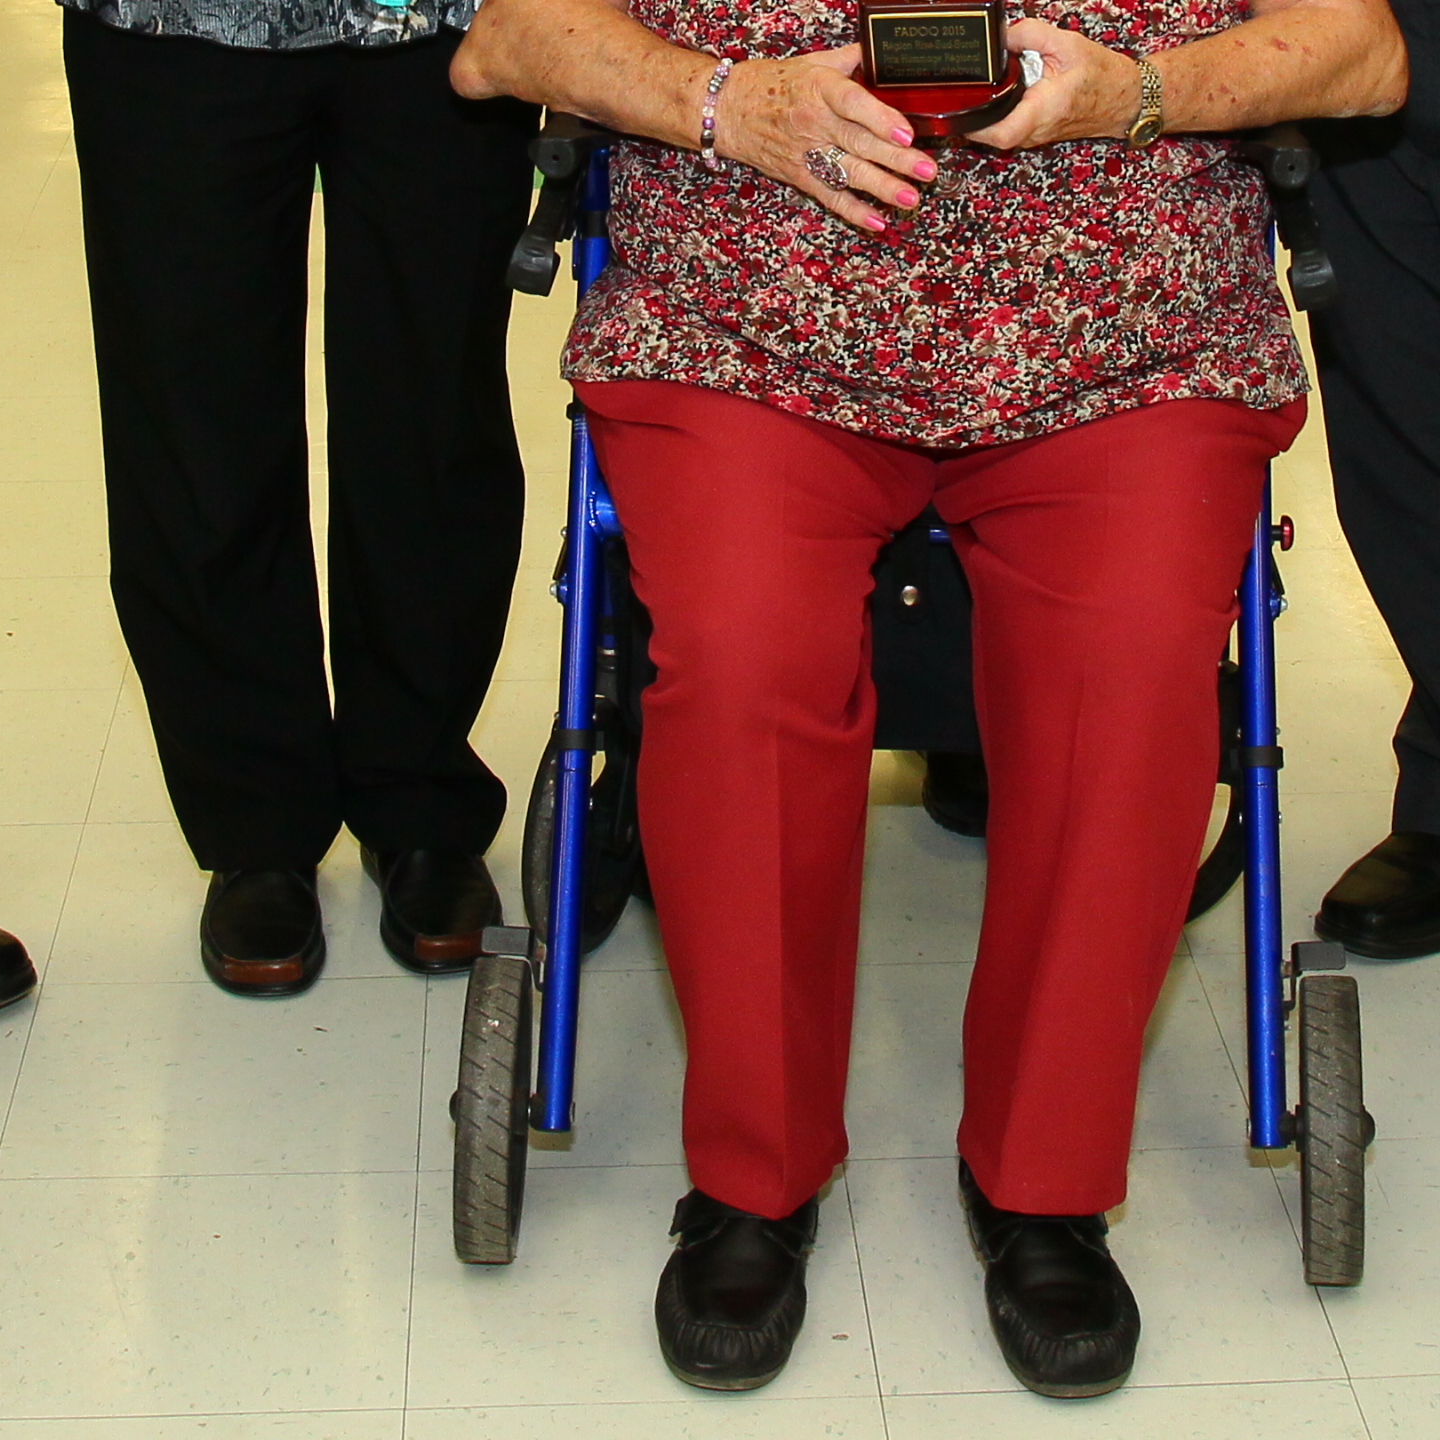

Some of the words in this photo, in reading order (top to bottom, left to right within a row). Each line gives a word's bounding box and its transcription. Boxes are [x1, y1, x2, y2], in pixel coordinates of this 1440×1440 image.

[894, 25, 940, 37] FADOQ
[941, 25, 966, 36] 2015
[884, 65, 931, 77] Carmen
[933, 63, 982, 76] Lefebvre
